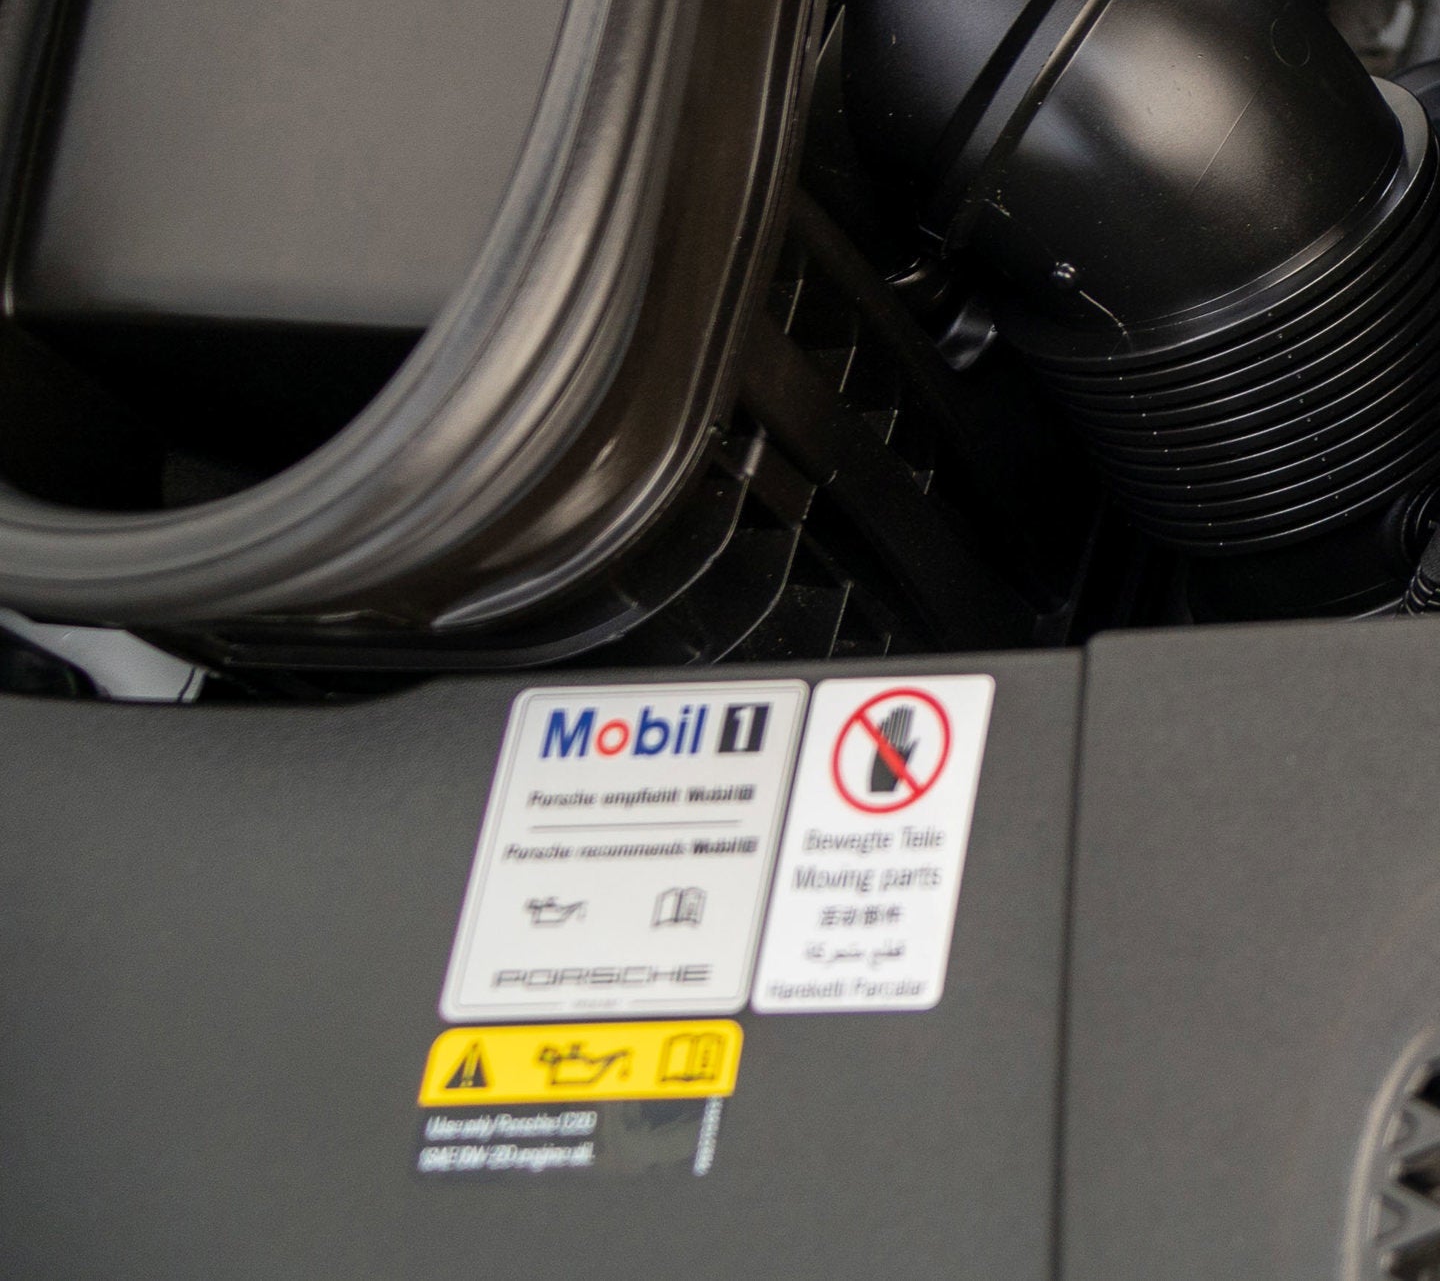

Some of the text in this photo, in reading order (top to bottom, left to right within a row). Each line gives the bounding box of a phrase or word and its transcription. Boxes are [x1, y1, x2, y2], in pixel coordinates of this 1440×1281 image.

[540, 703, 710, 759] Mobil
[804, 824, 946, 855] Bewegte Teile
[794, 864, 943, 893] Moving parts
[492, 964, 714, 989] PORSCHE
